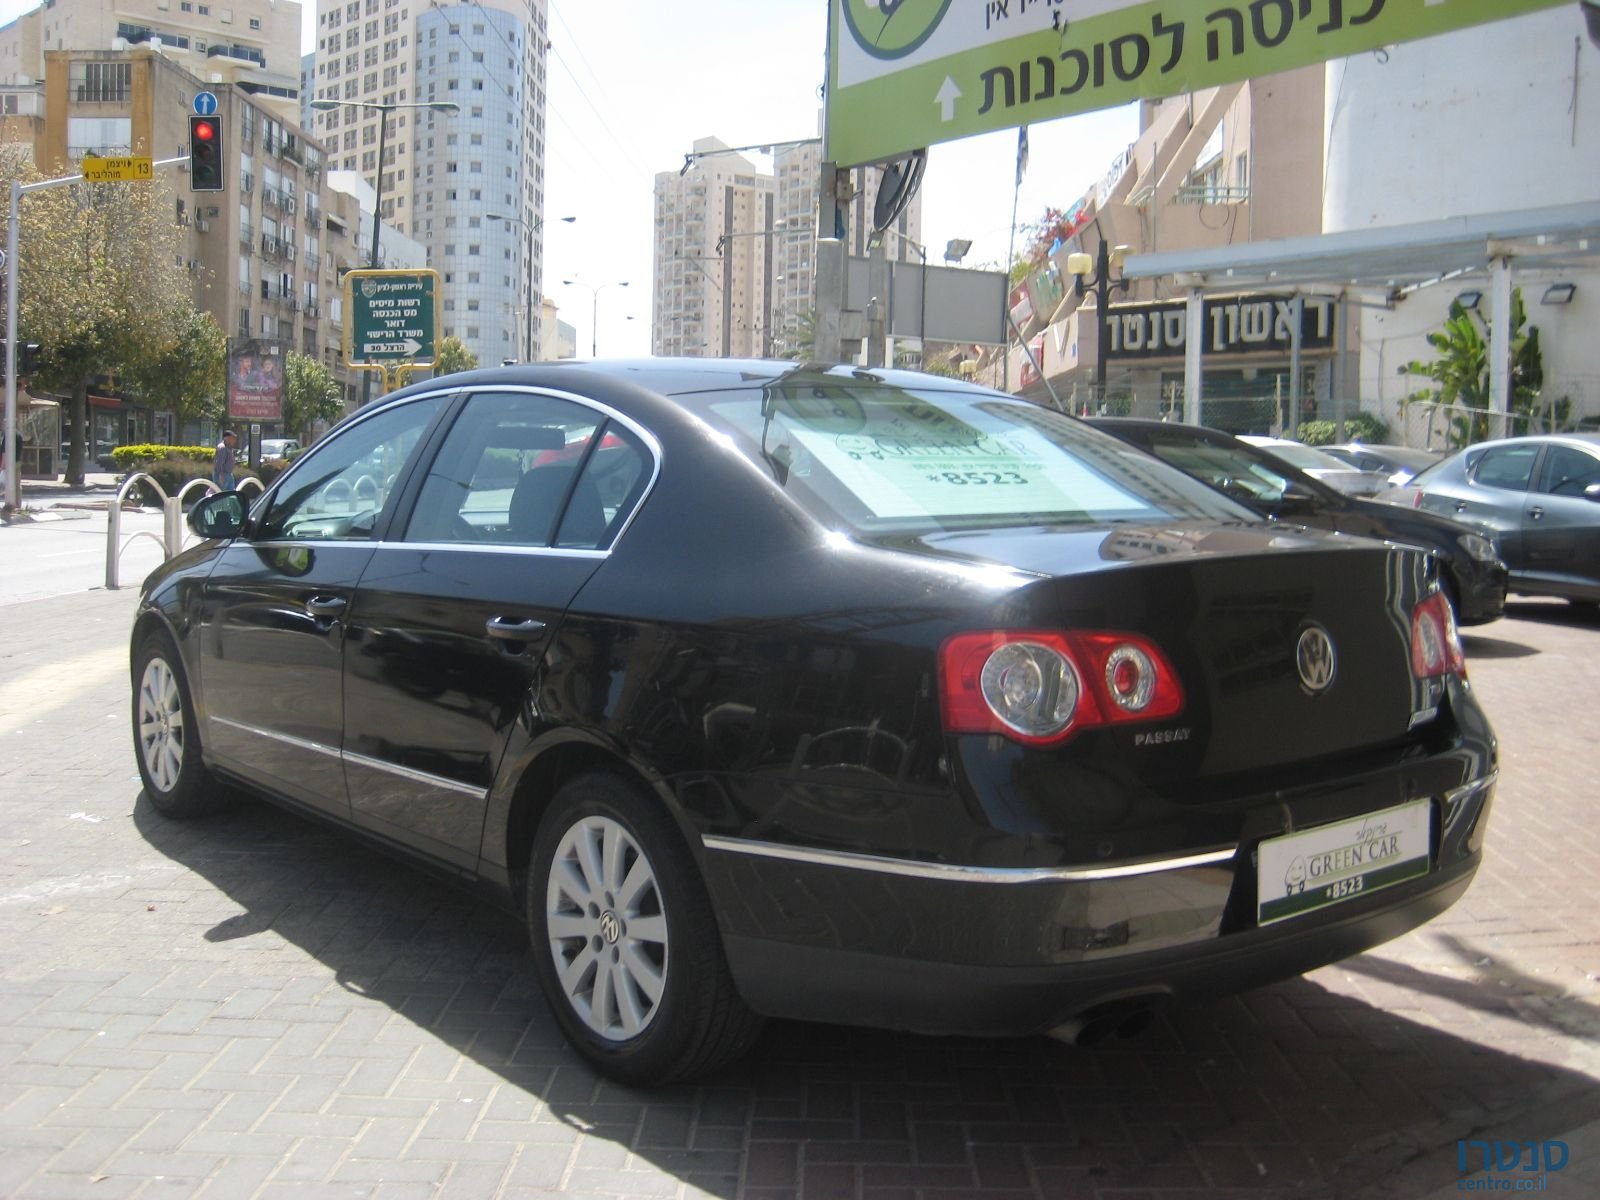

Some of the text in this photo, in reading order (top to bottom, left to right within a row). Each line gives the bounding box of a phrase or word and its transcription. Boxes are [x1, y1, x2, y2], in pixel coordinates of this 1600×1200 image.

[977, 12, 1185, 115] לסוכנות
[106, 160, 126, 170] ויצמן
[137, 163, 149, 174] 13
[397, 299, 421, 307] רשות
[372, 309, 418, 318] מס הכנסה
[384, 319, 406, 328] דואר
[1106, 298, 1331, 352] ראשון סנטר
[397, 329, 424, 337] משרד
[1309, 836, 1400, 878] GREEN CAR
